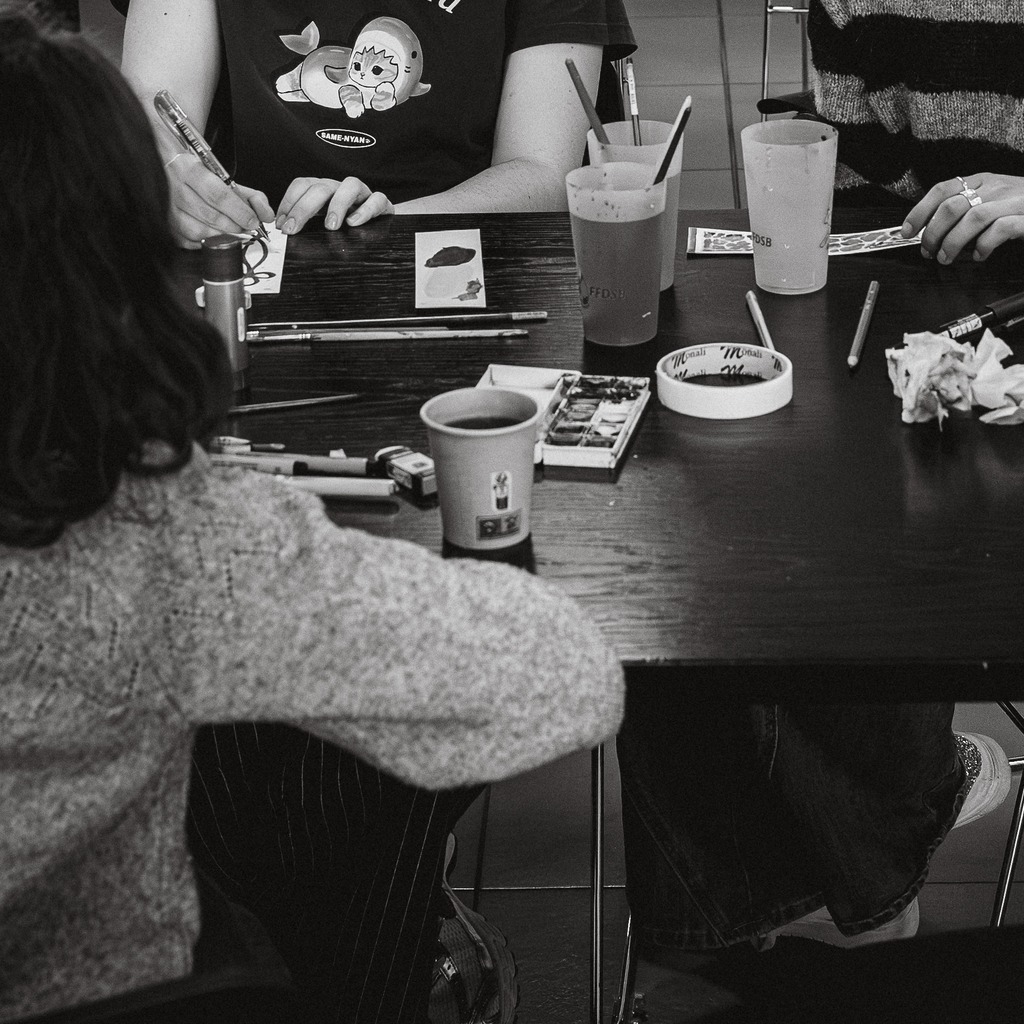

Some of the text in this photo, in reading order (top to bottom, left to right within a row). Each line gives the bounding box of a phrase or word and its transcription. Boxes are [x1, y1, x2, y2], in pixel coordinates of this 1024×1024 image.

[321, 132, 366, 144] SAME-NYAN
[671, 348, 706, 369] Monali
[720, 346, 763, 359] Monali
